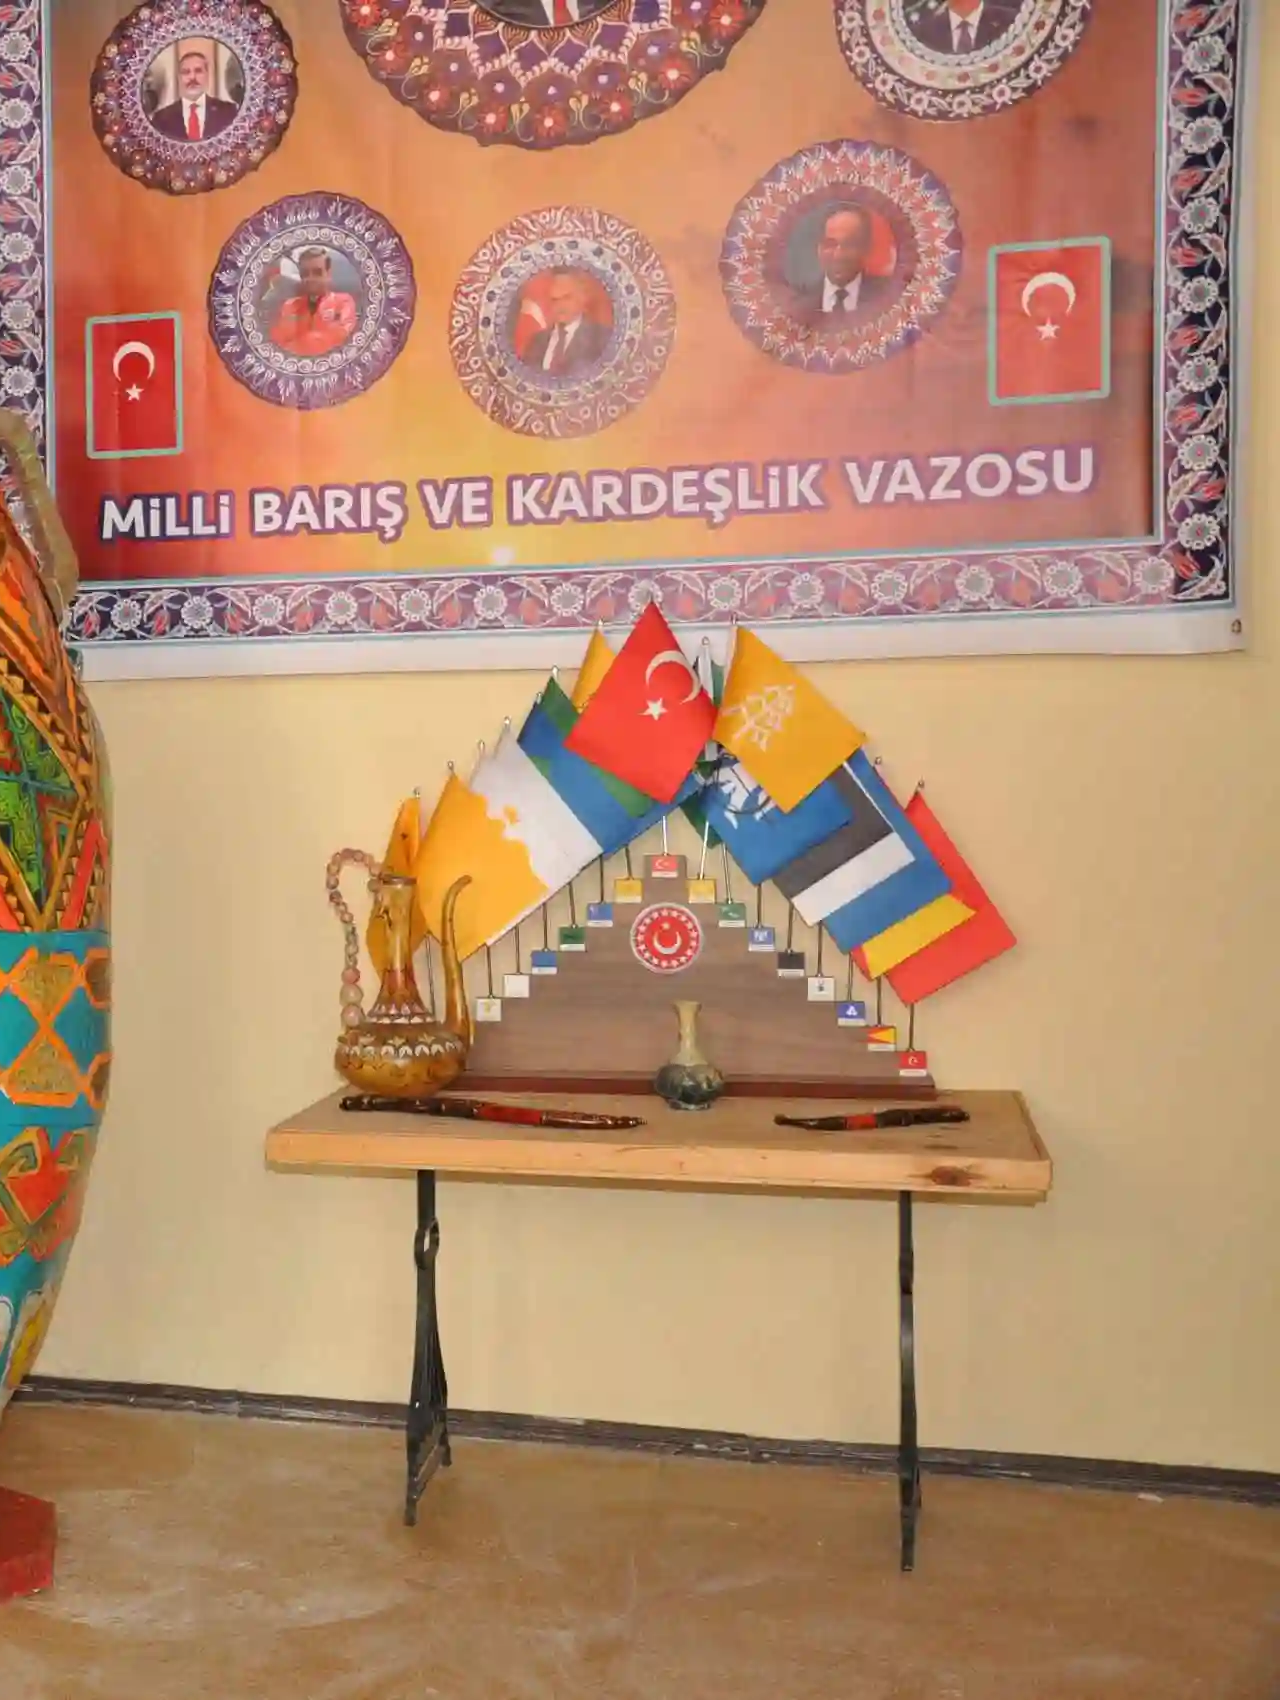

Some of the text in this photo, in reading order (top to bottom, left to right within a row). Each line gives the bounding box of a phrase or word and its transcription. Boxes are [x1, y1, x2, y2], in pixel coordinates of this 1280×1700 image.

[253, 484, 406, 539] BARIŞ
[422, 482, 488, 524] VE
[844, 446, 1094, 504] VAZOSU
